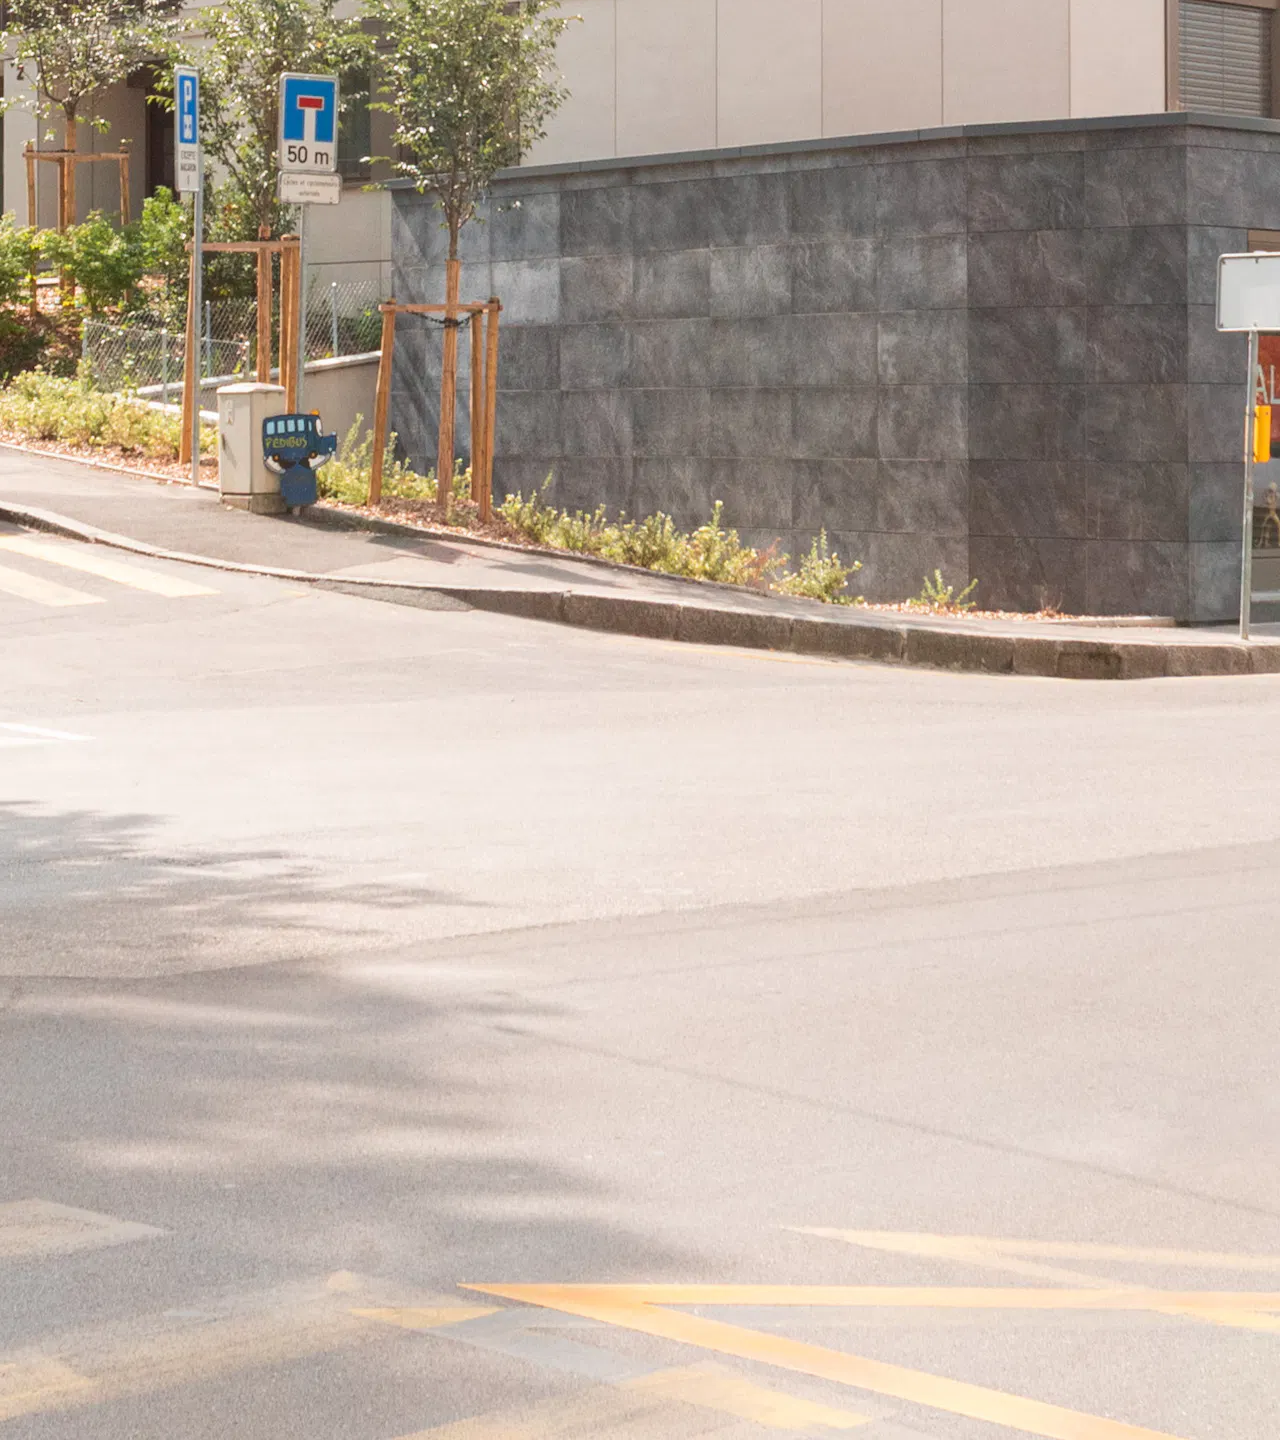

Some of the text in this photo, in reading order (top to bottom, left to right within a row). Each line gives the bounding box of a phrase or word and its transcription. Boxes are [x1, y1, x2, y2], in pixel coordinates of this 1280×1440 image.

[287, 145, 329, 165] 50 m
[265, 436, 307, 448] PEDIBUS
